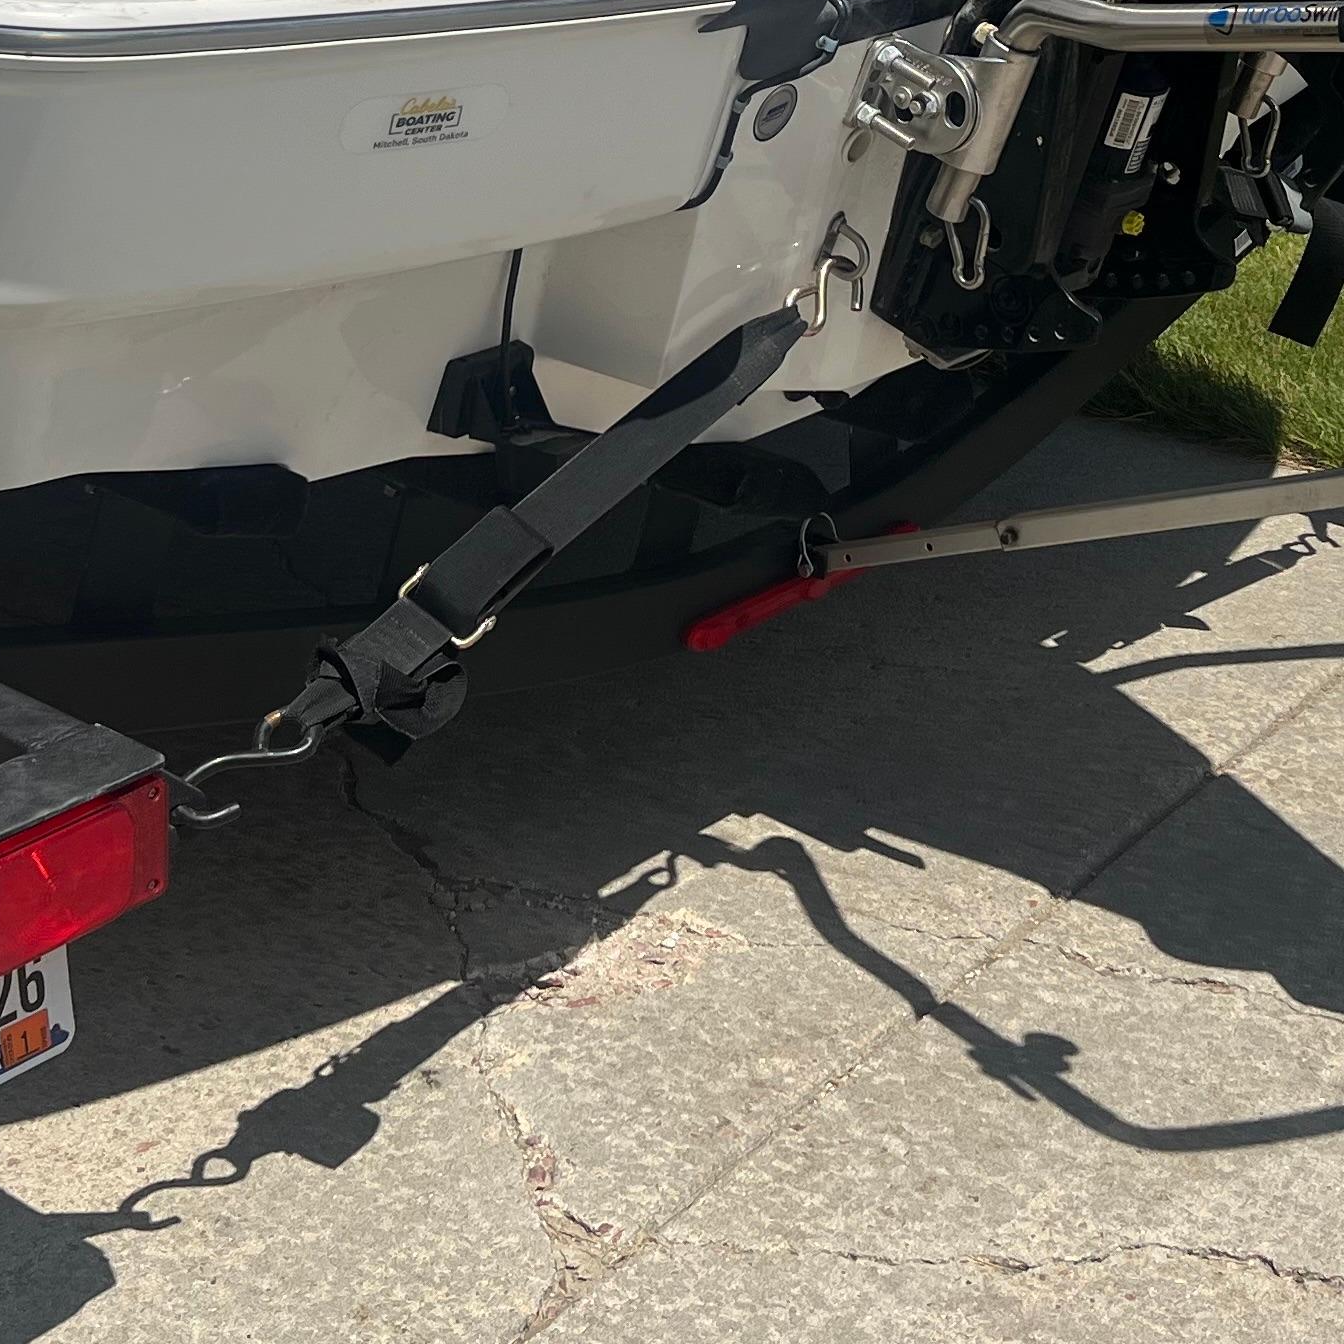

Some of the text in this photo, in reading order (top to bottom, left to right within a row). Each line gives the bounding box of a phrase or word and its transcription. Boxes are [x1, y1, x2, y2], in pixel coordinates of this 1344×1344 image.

[396, 111, 456, 128] BOATING
[404, 124, 443, 136] CENTER
[412, 134, 437, 146] South
[439, 131, 469, 142] Dakota
